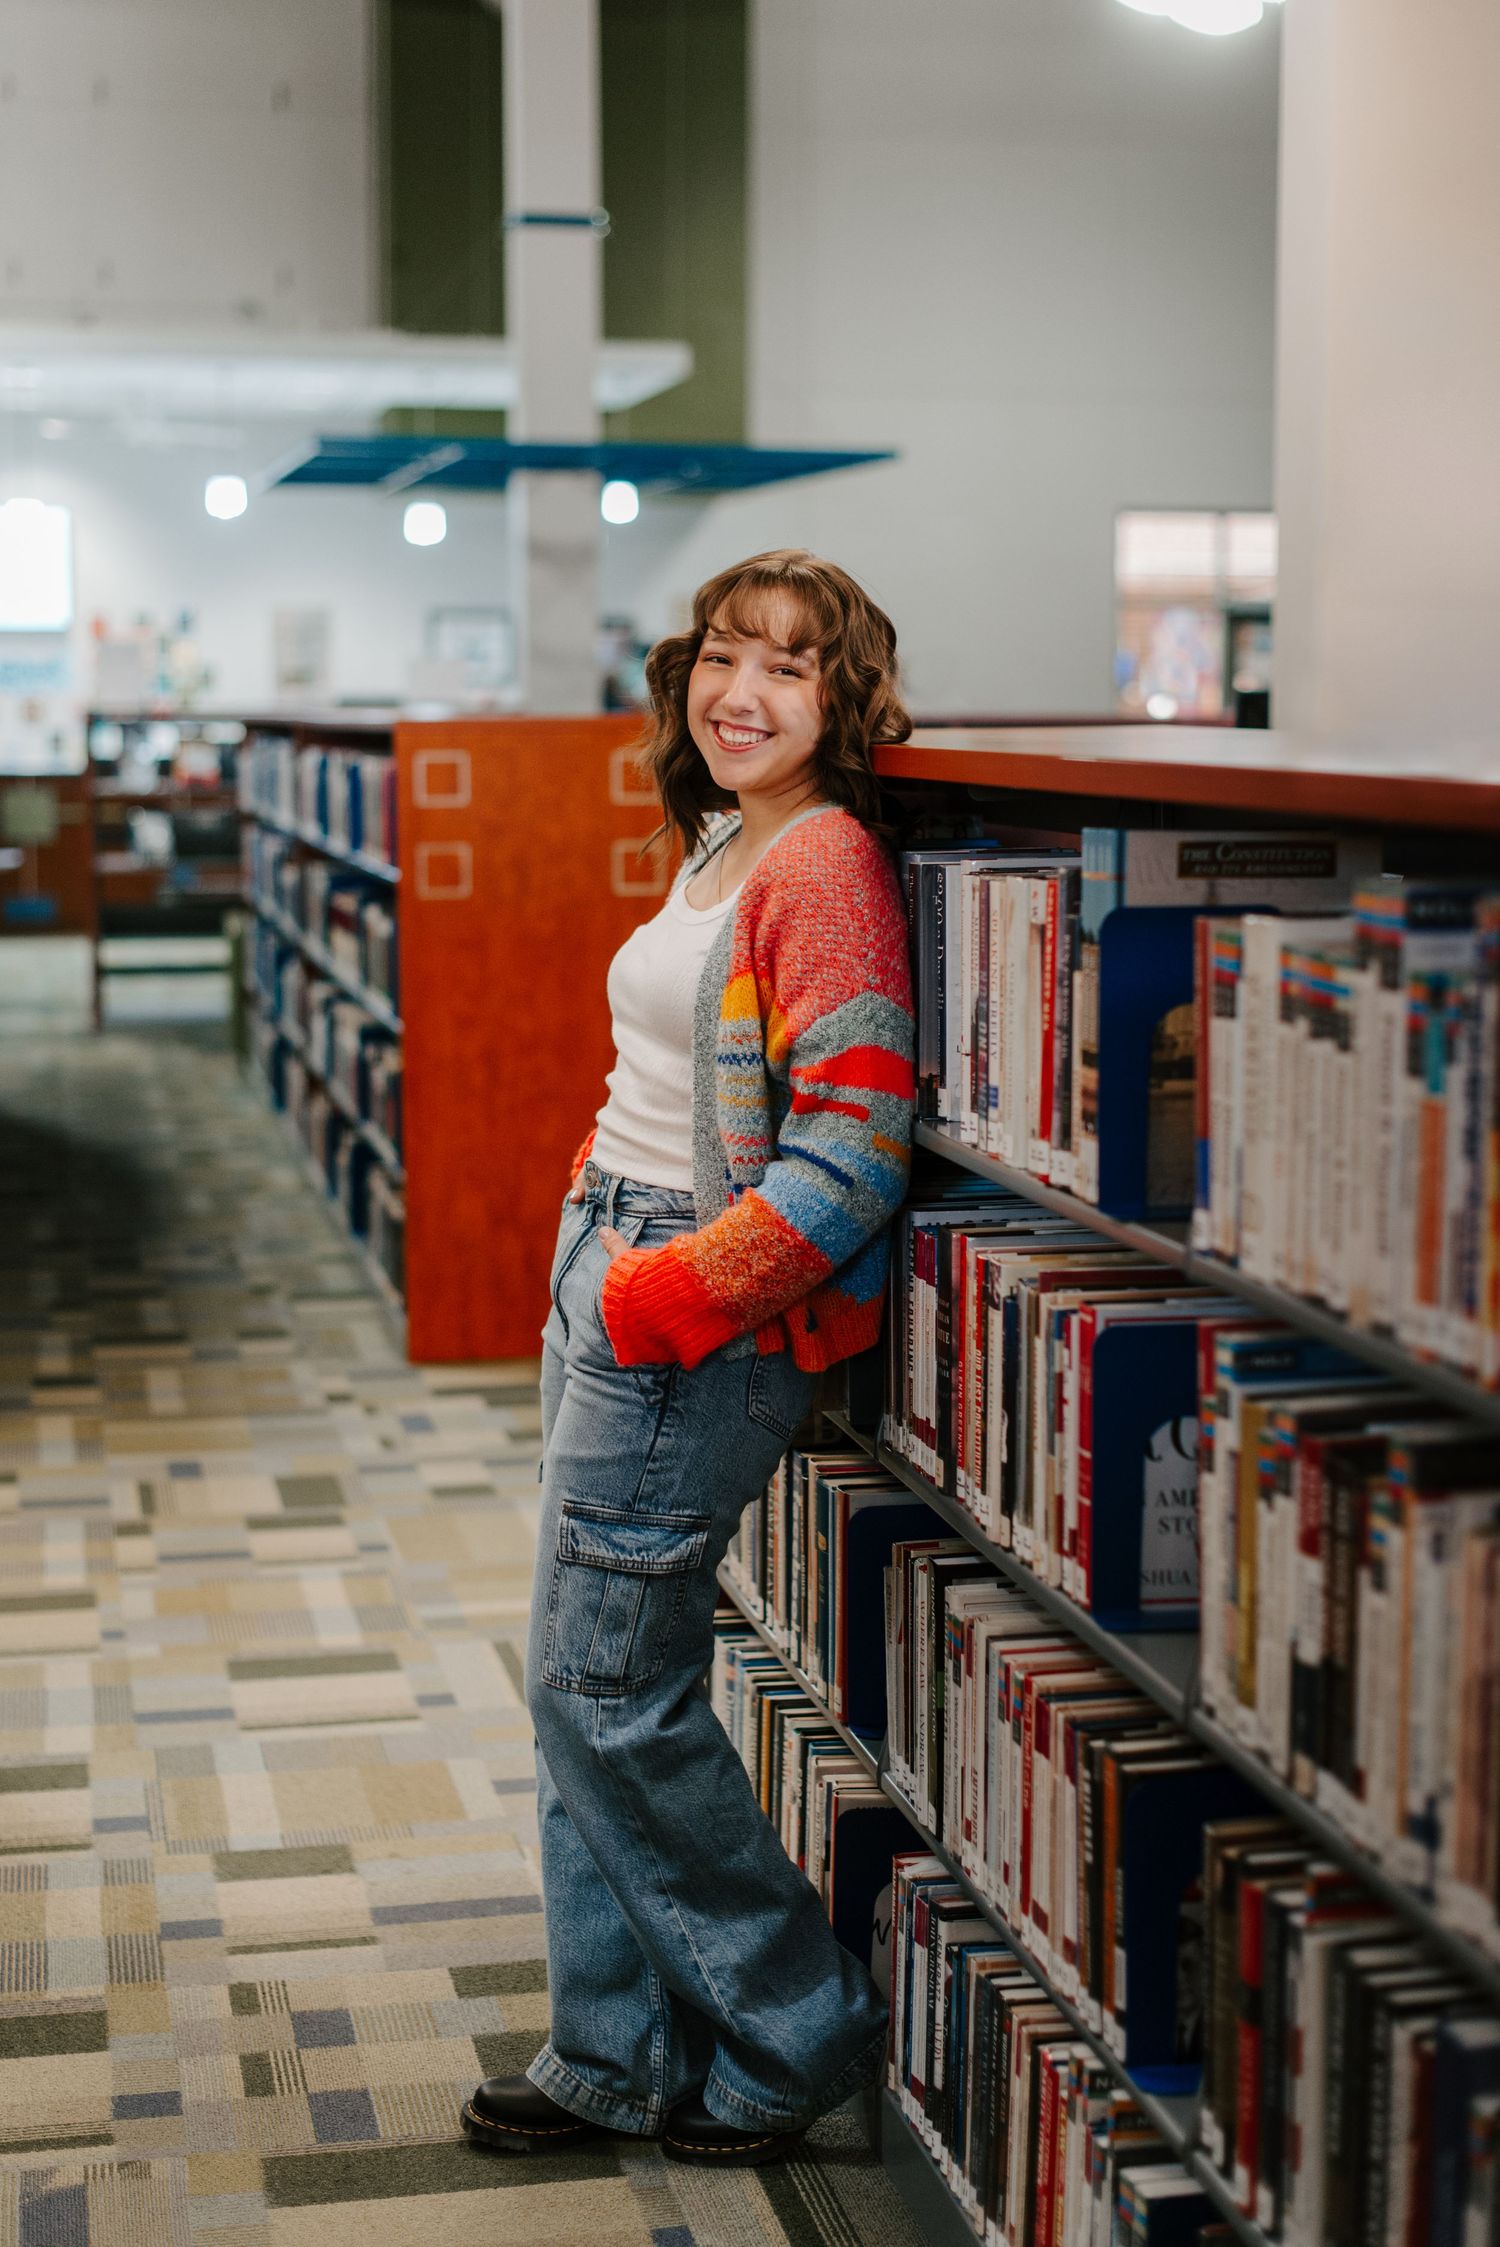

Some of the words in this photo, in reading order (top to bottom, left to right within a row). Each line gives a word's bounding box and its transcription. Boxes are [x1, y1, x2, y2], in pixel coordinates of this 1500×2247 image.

[1182, 847, 1211, 862] THE
[1215, 842, 1330, 862] CONSTITUTION
[990, 908, 999, 993] SPEAKING
[990, 999, 998, 1060] FREELY
[989, 2074, 997, 2136] INJUSTICE
